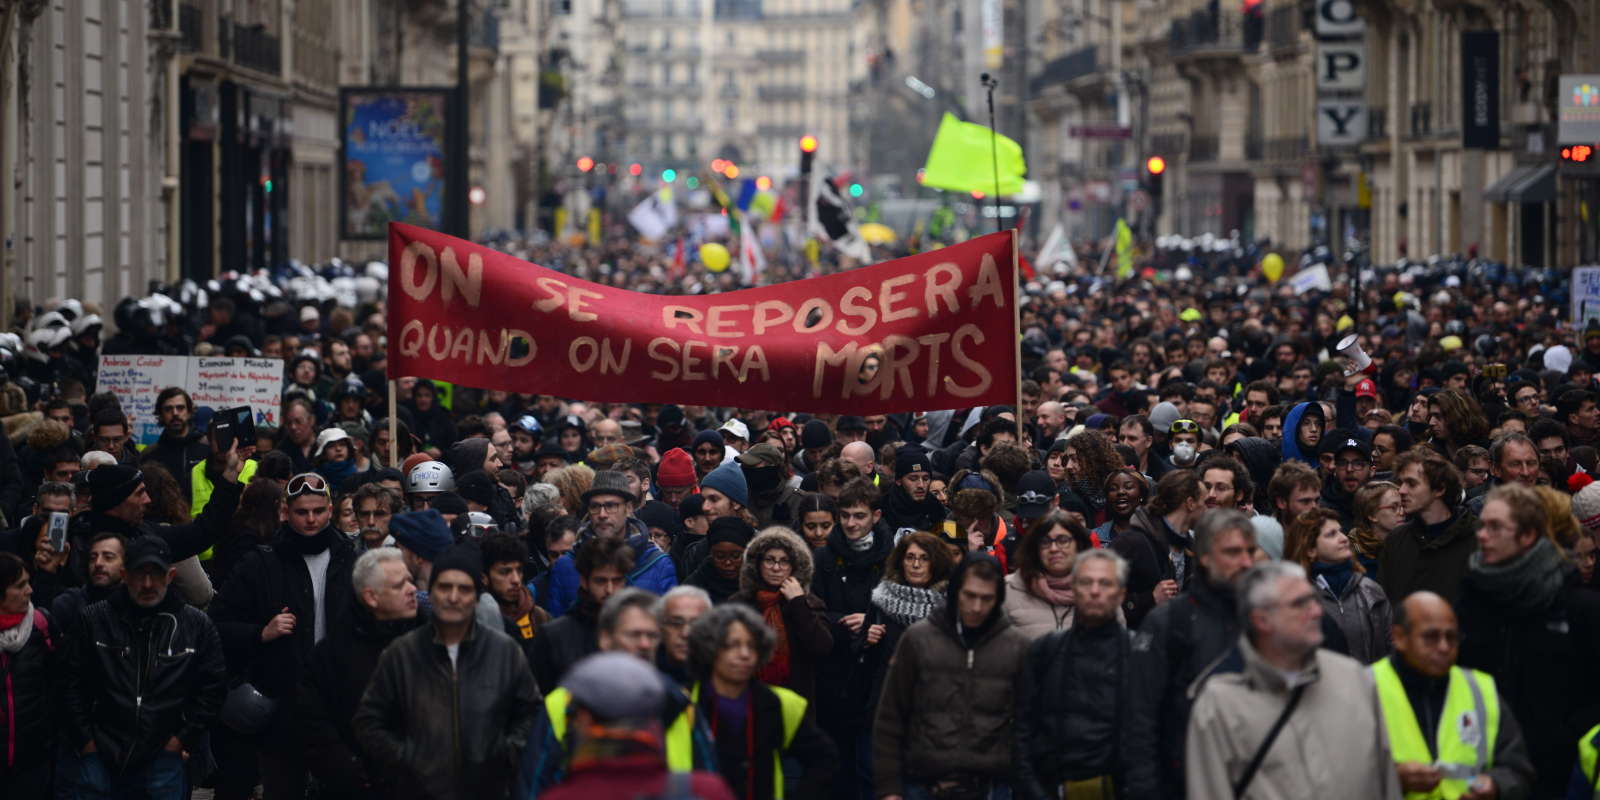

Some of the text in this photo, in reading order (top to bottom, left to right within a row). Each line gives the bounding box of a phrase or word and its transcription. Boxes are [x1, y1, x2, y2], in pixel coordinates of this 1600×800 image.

[400, 240, 1005, 339] ON SE REPOSERA
[400, 319, 992, 401] QUAND ON SERA MORTS
